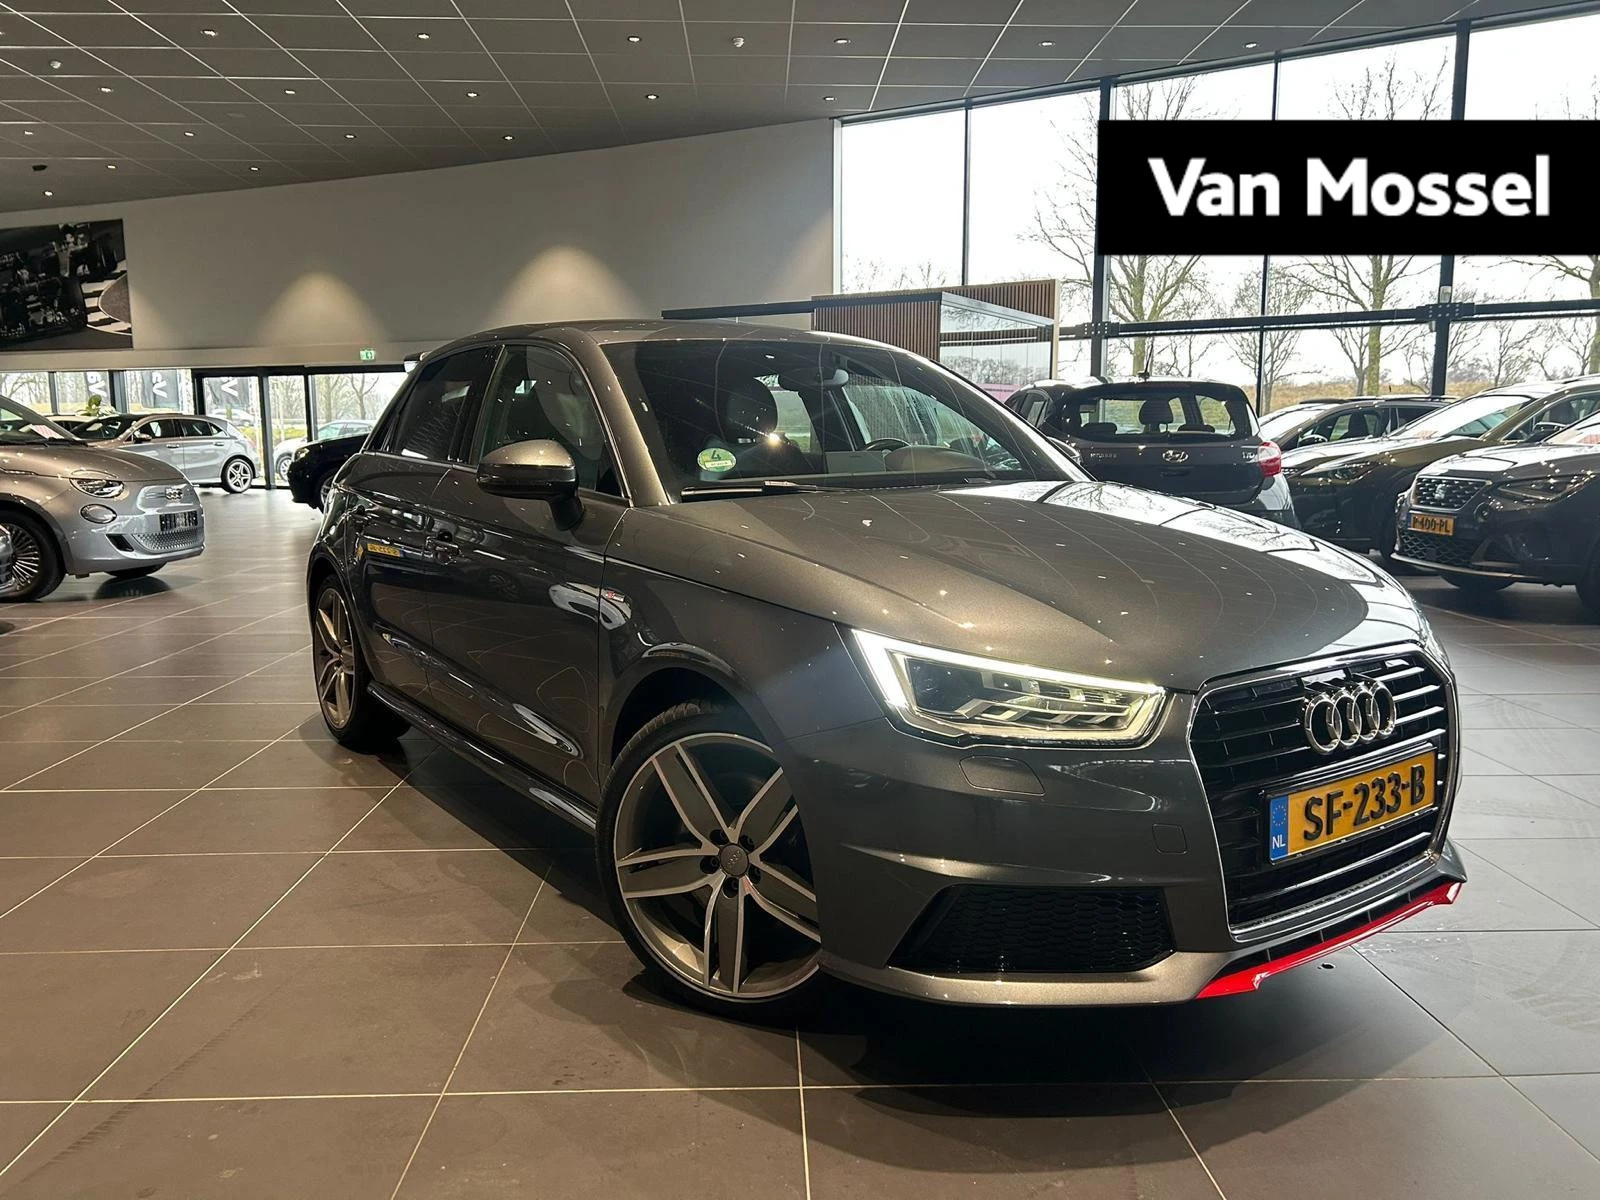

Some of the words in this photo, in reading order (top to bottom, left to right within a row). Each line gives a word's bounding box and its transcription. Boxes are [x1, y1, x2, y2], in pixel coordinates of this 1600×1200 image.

[711, 449, 722, 460] 4
[1272, 834, 1286, 850] NL
[1303, 763, 1426, 841] SF-233-B
